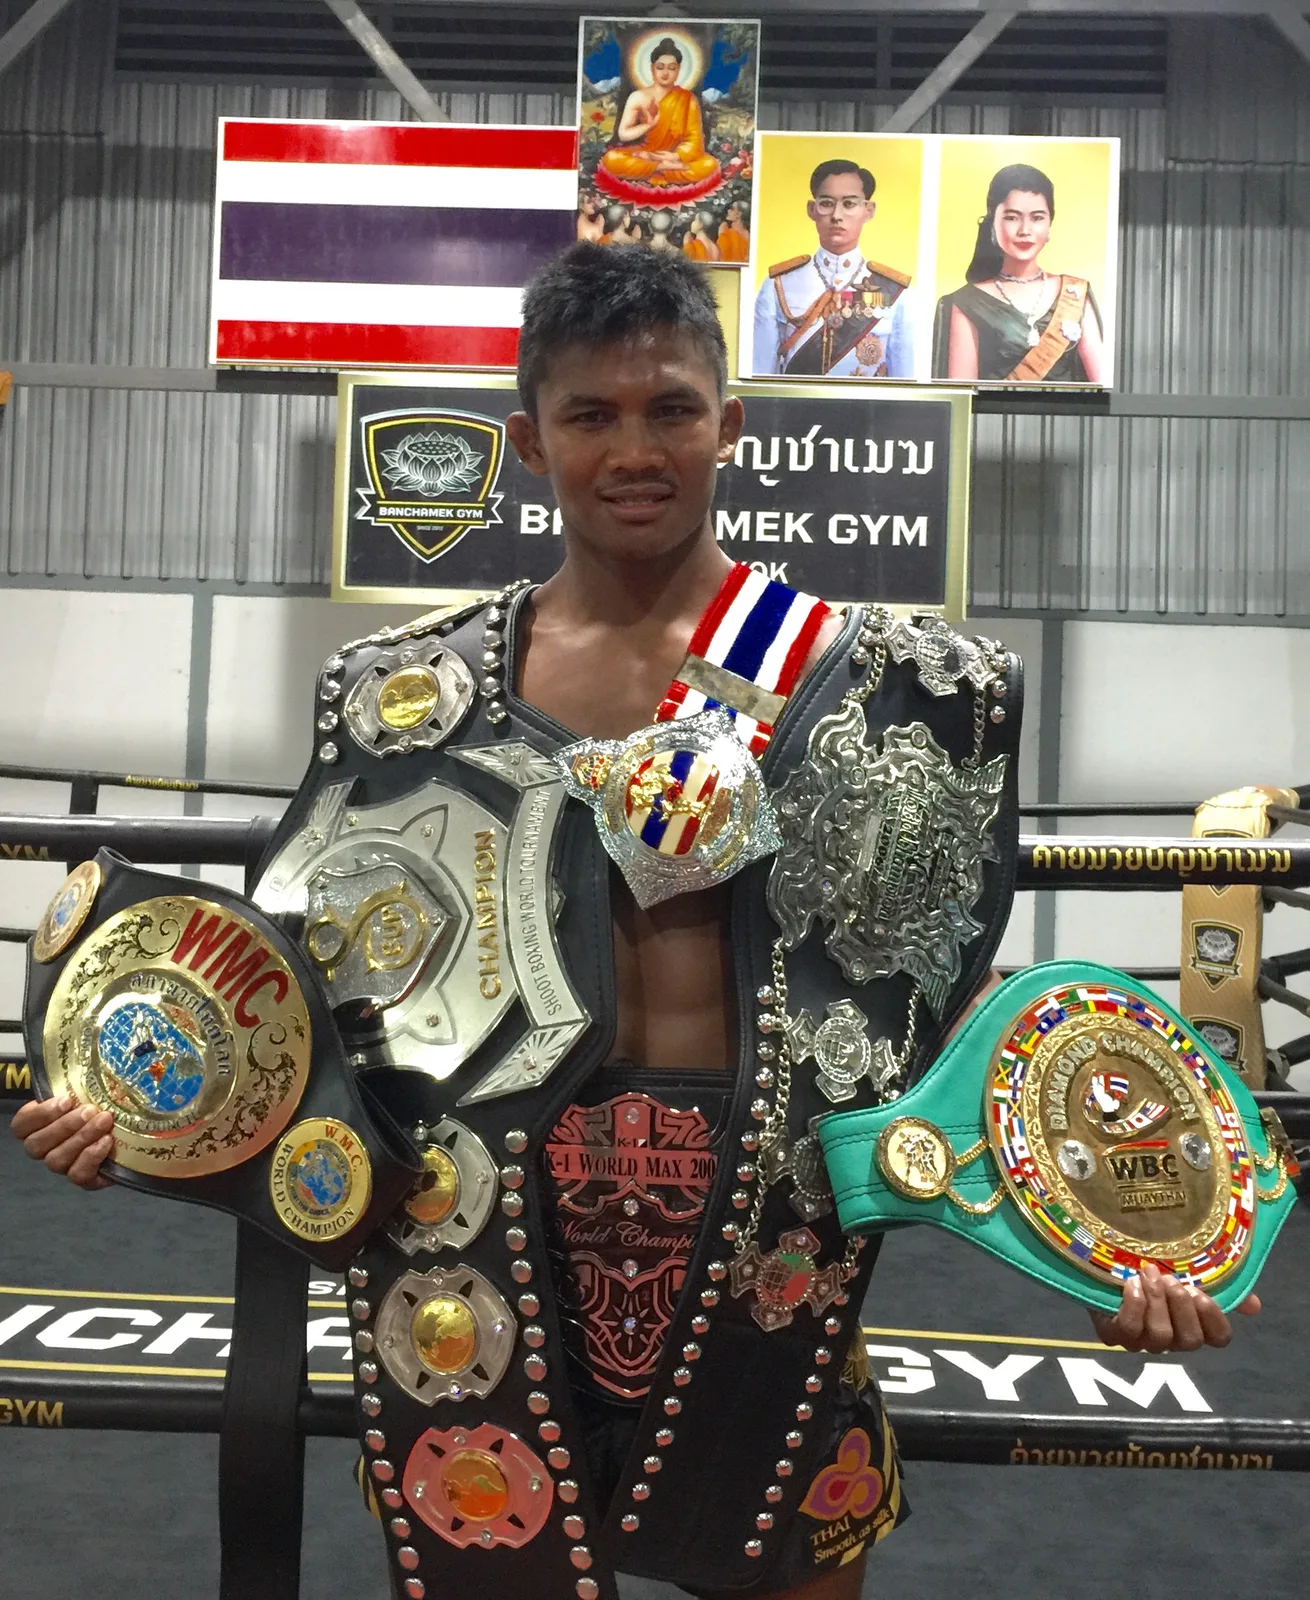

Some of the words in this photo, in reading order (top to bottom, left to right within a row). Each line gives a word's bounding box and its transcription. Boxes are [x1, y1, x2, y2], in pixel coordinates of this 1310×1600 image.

[717, 424, 935, 487] ญชาเมฆ
[379, 506, 454, 518] BANCHAMEK
[456, 509, 483, 519] GYM
[828, 513, 929, 547] GYM
[519, 788, 551, 874] TOURNAMENT
[474, 828, 501, 1000] CHAMPION
[519, 876, 535, 923] WORLD
[170, 907, 291, 1030] WMC
[522, 924, 546, 973] BOXING
[533, 974, 562, 1016] SHOOT
[1050, 1035, 1098, 1131] DIAMOND
[1099, 1031, 1200, 1122] CHAMPION
[617, 1137, 637, 1147] K-1
[273, 1142, 295, 1203] WORLD
[690, 1158, 717, 1179] 200
[1109, 1153, 1180, 1181] WBC
[283, 1206, 355, 1236] CHAMPION
[616, 1221, 697, 1256] Champi
[810, 1515, 851, 1546] THAI
[814, 1532, 857, 1565] Smooth
[858, 1524, 872, 1539] as
[872, 1508, 892, 1529] silk
